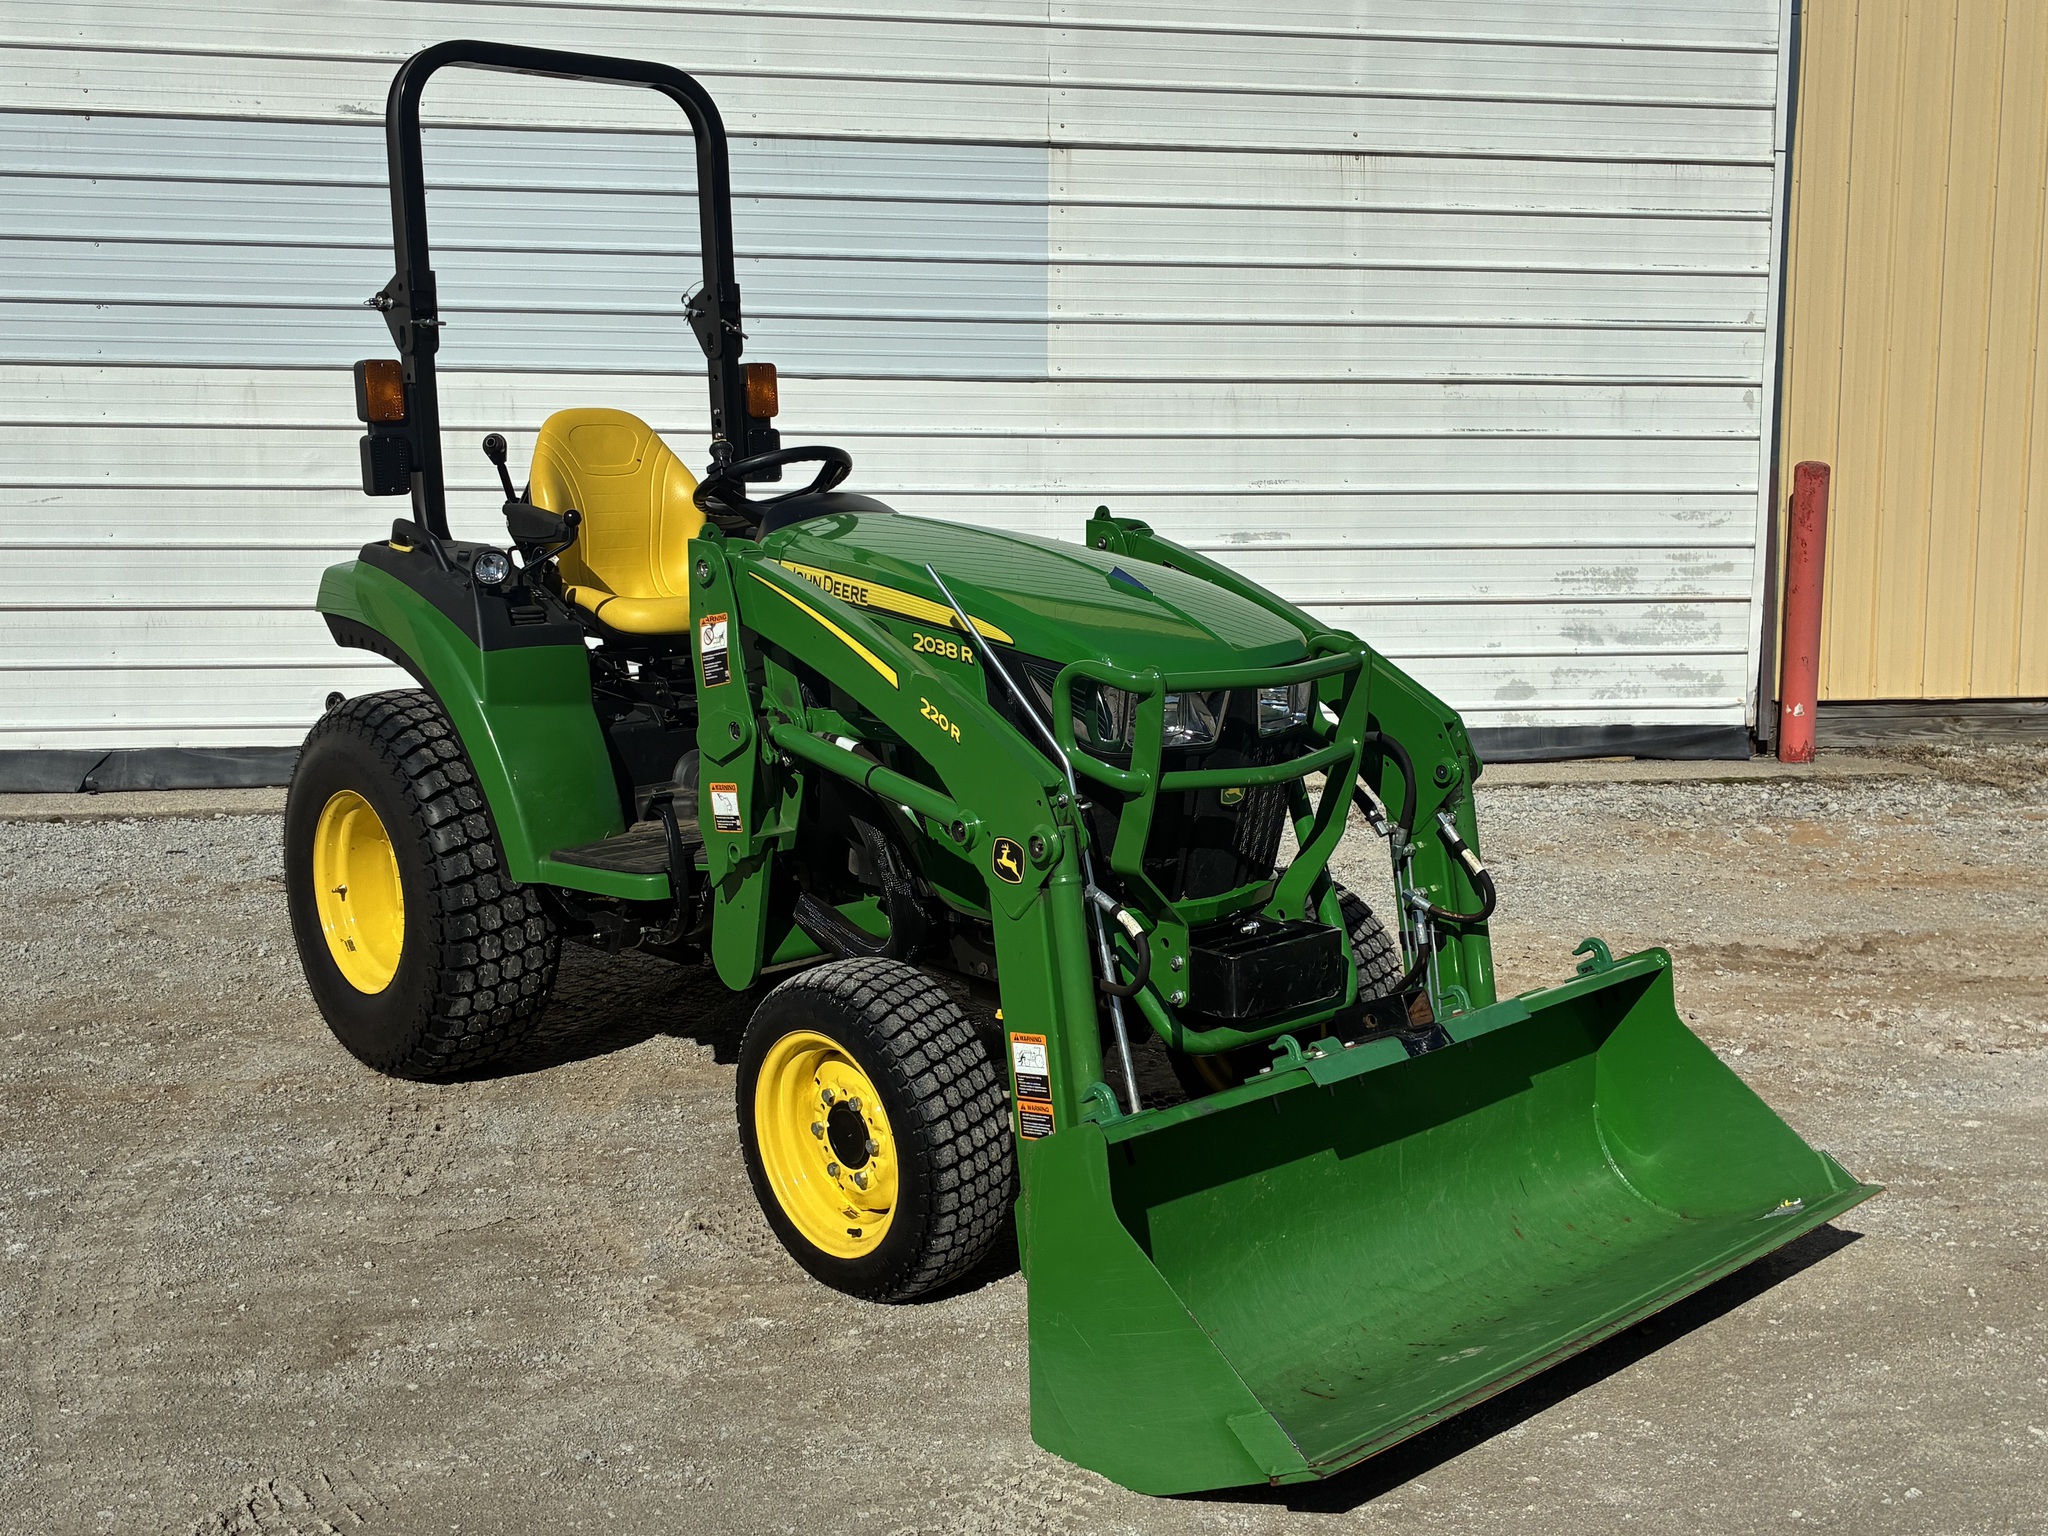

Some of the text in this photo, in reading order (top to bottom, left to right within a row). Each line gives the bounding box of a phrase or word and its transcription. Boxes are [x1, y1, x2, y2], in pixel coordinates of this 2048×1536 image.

[823, 575, 869, 604] DEERE
[705, 613, 727, 622] ARNING
[912, 632, 974, 664] 2038 R
[920, 697, 961, 744] 220 R
[1019, 1035, 1042, 1043] WARNING
[1026, 1104, 1050, 1113] WARNING
